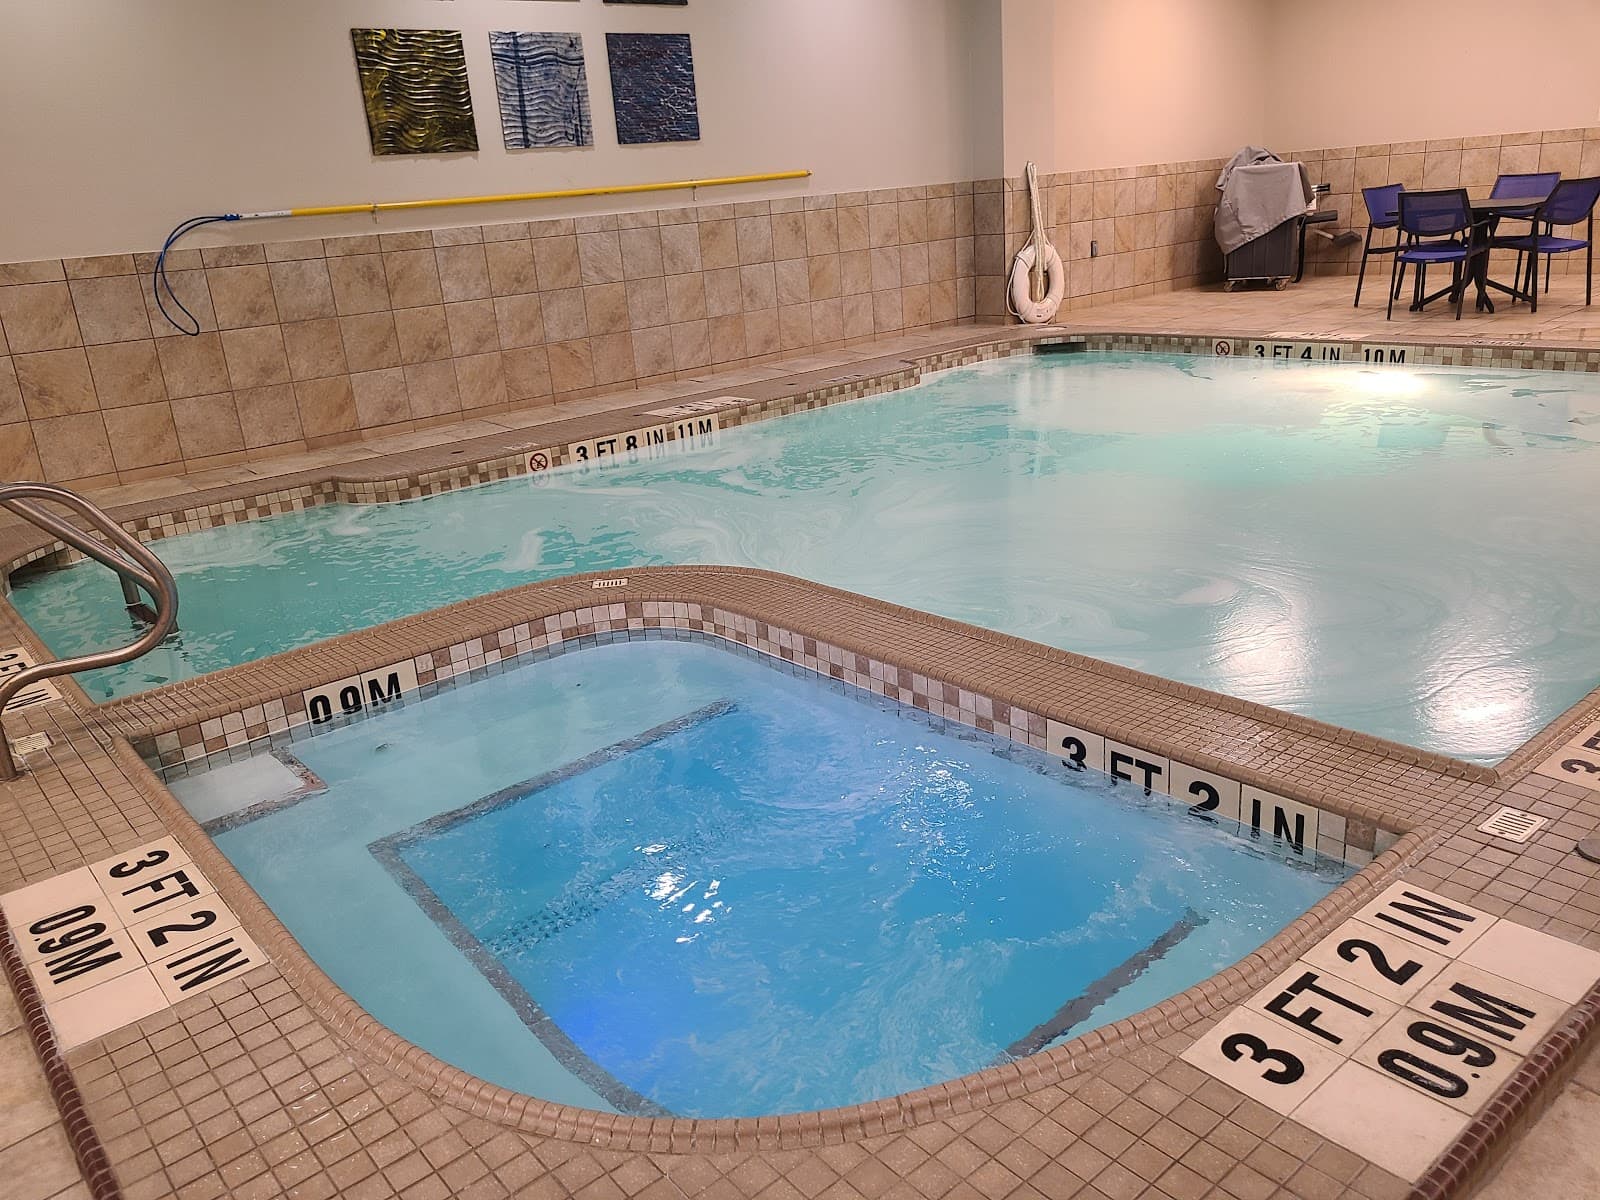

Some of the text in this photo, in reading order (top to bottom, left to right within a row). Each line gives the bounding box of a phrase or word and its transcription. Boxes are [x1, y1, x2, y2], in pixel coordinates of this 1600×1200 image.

[1255, 345, 1340, 361] 3 FT 4 IN
[576, 429, 664, 461] 3 FT 8 IN
[1061, 736, 1305, 856] 3 FT 2 IN
[109, 850, 250, 992] 3 FT 2 IN
[1221, 891, 1477, 1085] 3 FT 2 IN
